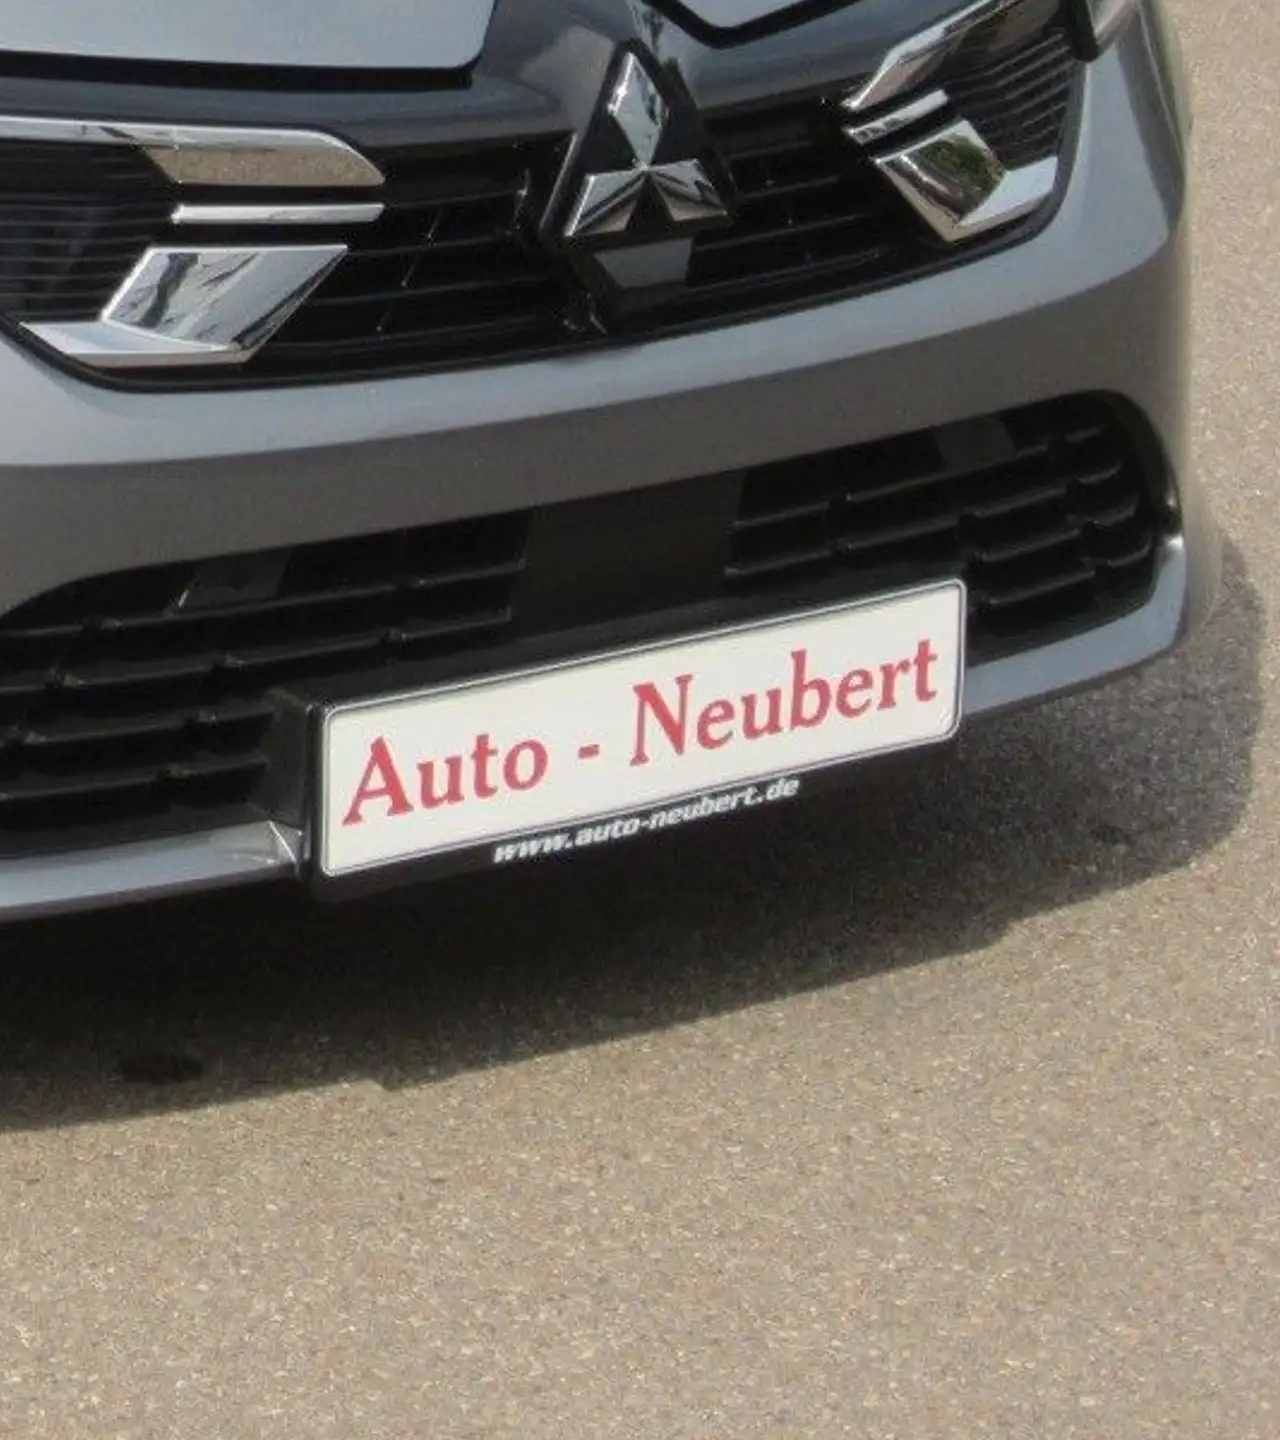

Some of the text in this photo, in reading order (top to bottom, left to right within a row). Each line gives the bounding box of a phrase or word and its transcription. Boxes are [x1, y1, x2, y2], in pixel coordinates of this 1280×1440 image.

[342, 638, 939, 827] Auto - Neubert
[494, 776, 801, 863] www.auto-neubert.de
